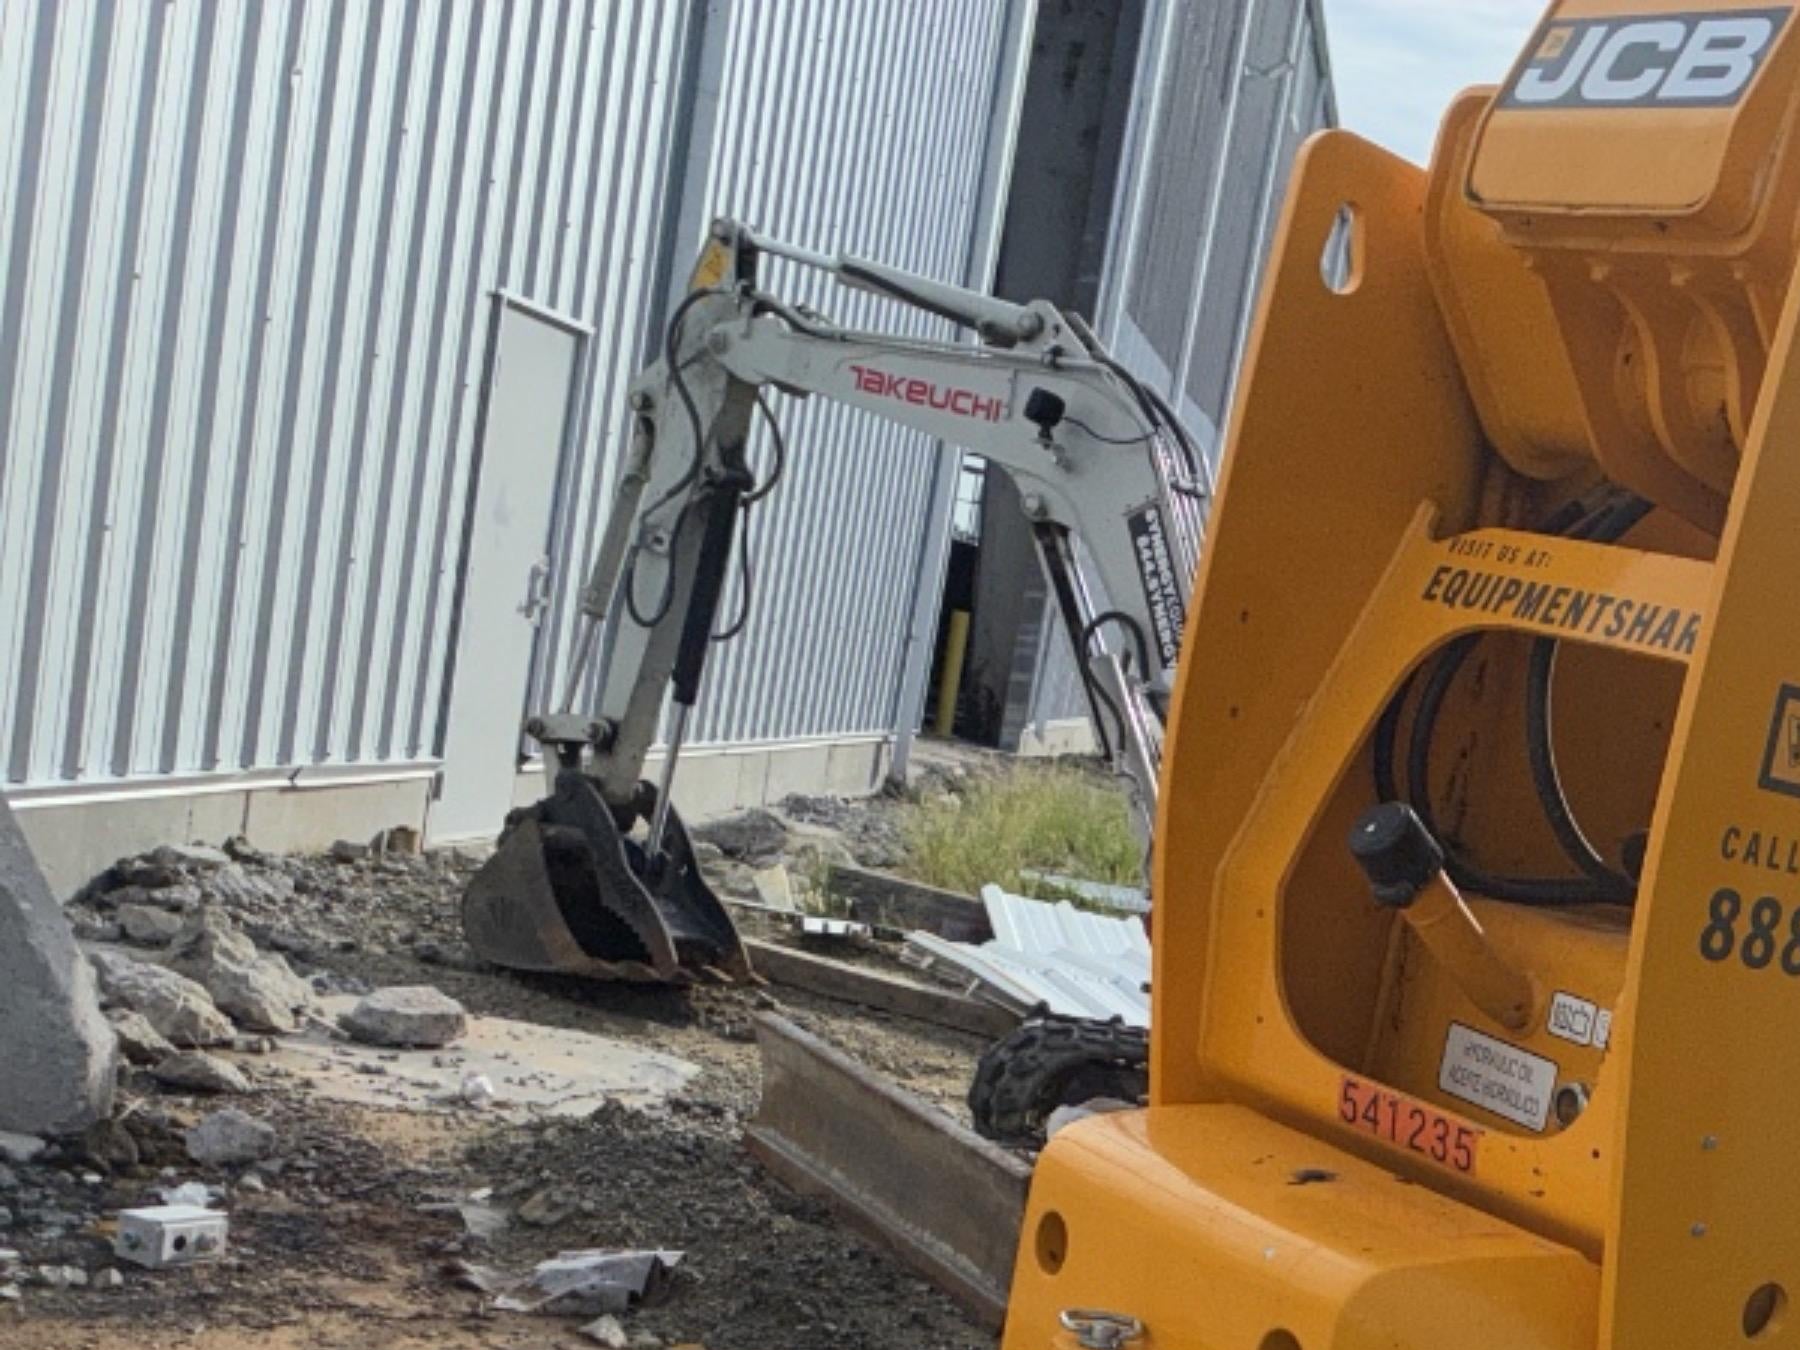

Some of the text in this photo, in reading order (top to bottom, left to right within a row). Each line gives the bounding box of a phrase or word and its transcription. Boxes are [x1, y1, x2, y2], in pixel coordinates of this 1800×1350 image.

[1514, 17, 1773, 101] JCB
[1721, 826, 1799, 876] CALL
[1341, 1078, 1472, 1171] 541235
